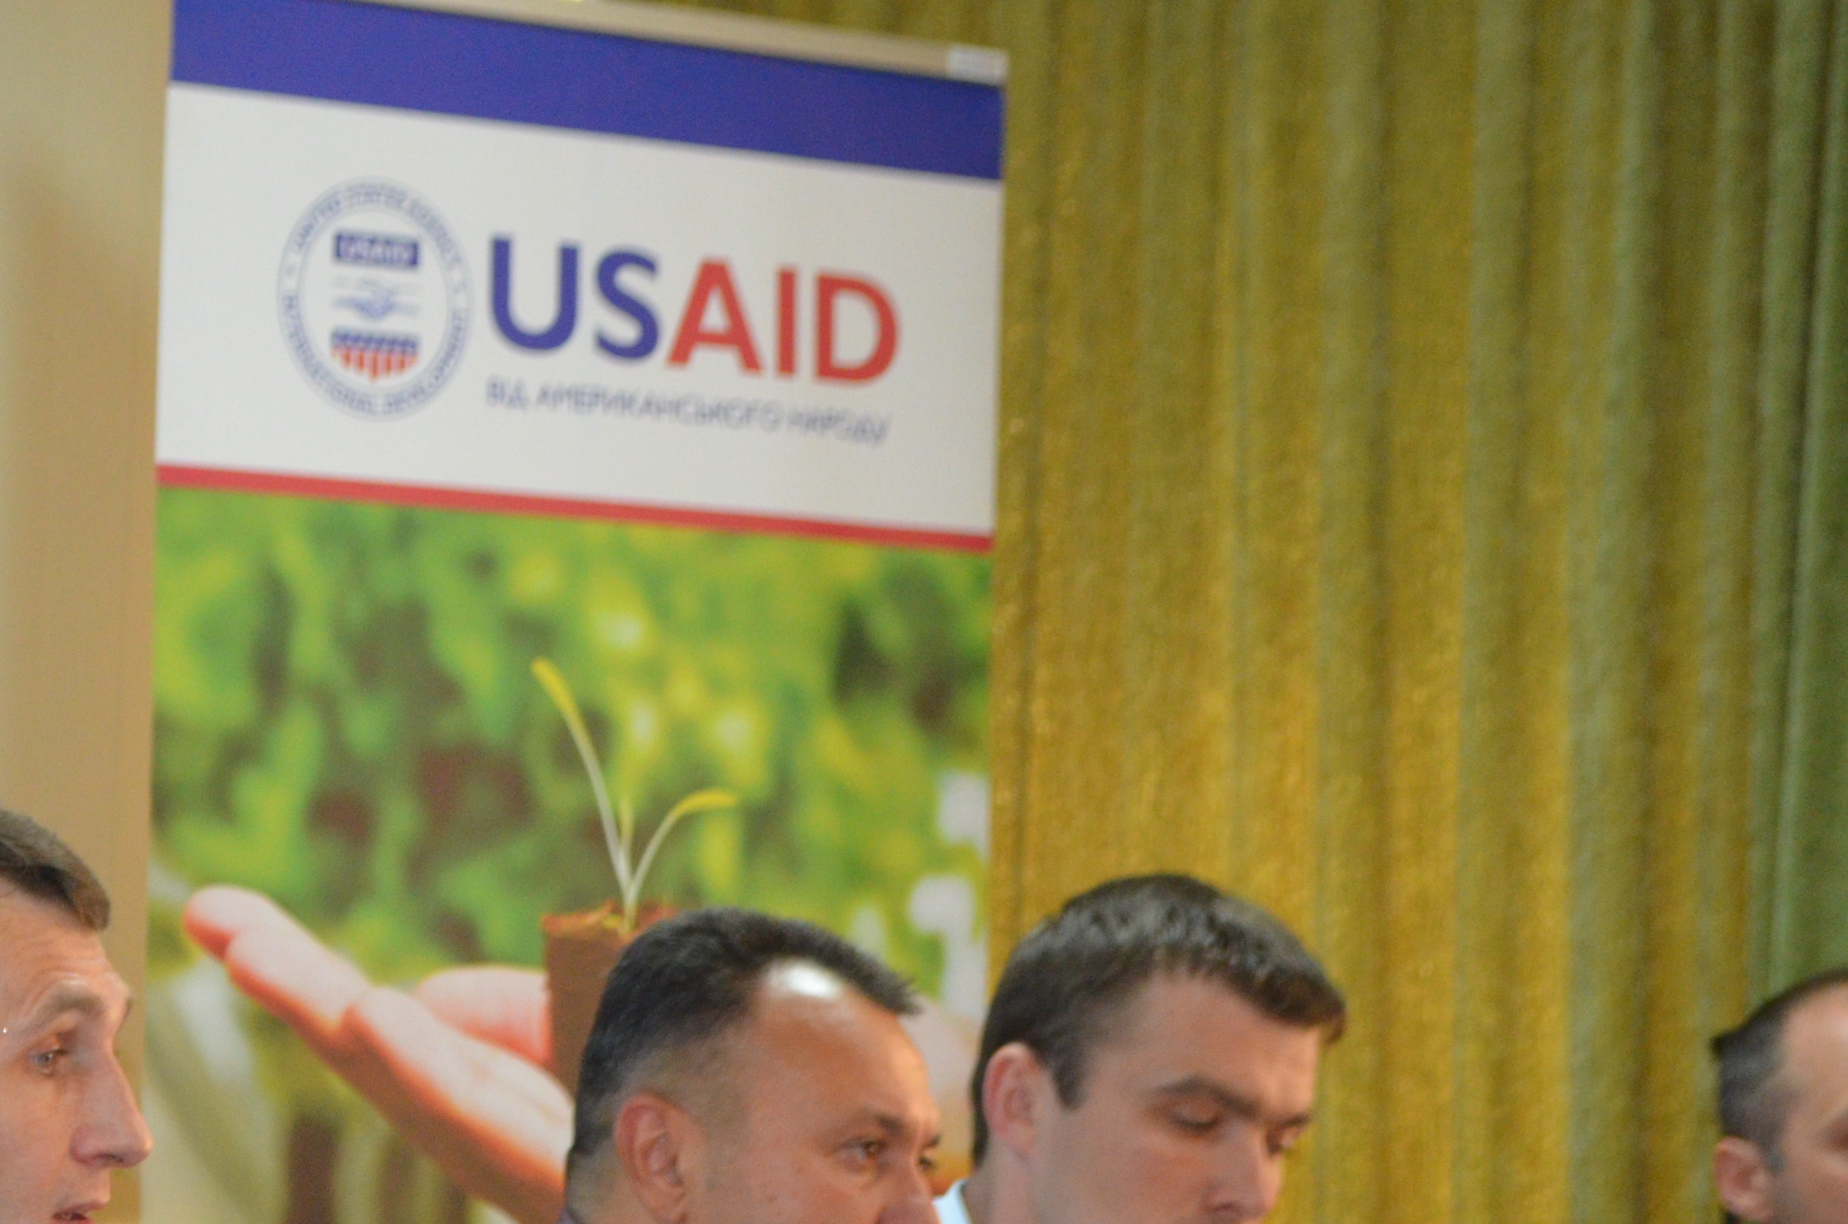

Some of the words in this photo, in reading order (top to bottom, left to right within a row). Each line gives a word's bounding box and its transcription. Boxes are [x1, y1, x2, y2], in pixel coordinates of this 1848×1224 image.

[488, 232, 901, 387] USAID
[484, 374, 531, 413] ВІД
[534, 381, 784, 434] АМЕРИКАНСЬКОГО
